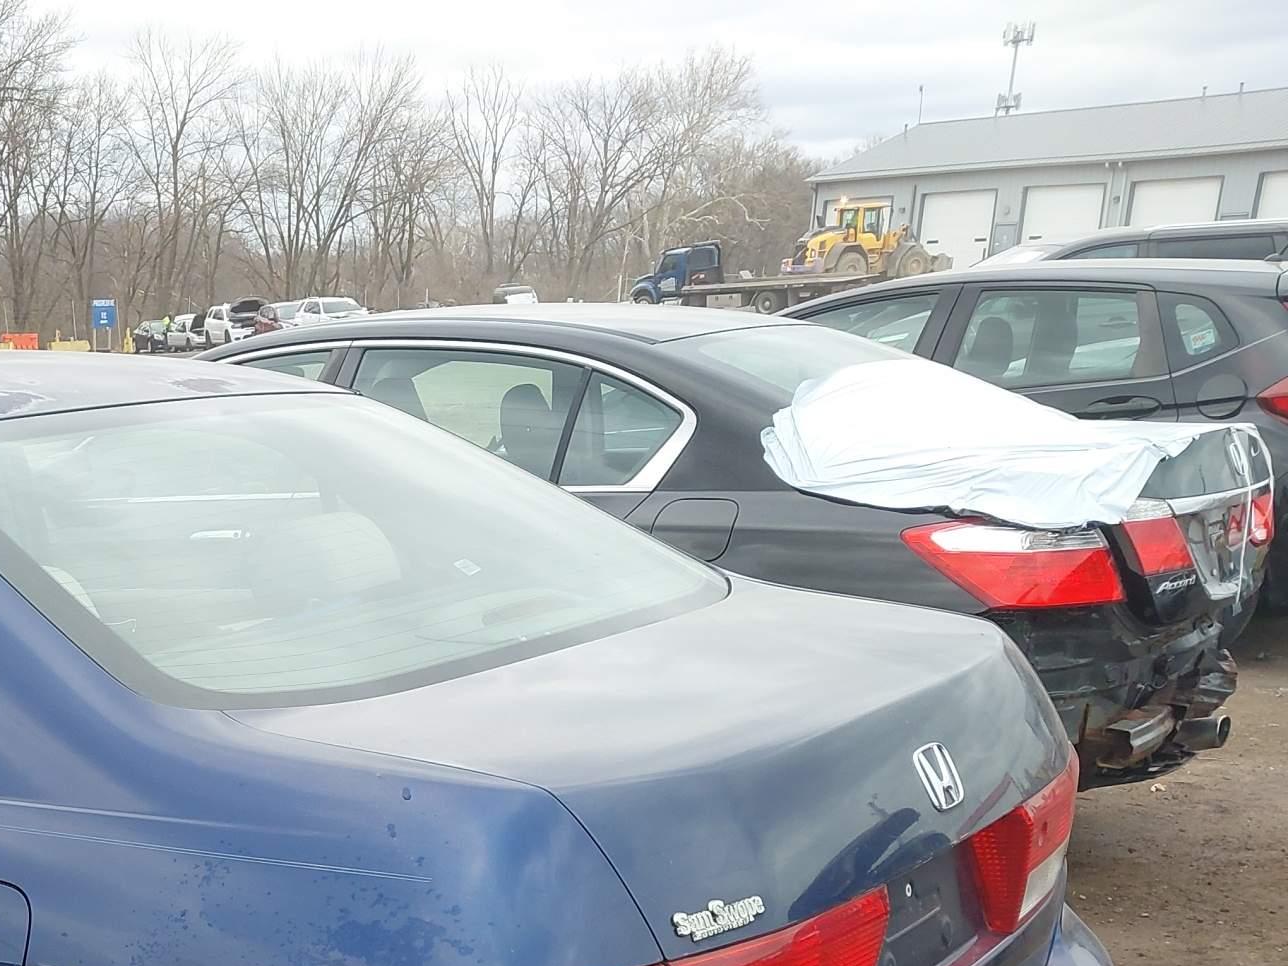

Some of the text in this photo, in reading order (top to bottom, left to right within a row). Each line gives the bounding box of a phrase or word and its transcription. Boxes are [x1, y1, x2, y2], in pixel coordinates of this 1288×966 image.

[1155, 574, 1196, 594] Accord
[673, 911, 716, 935] Sam
[708, 895, 765, 926] Swope
